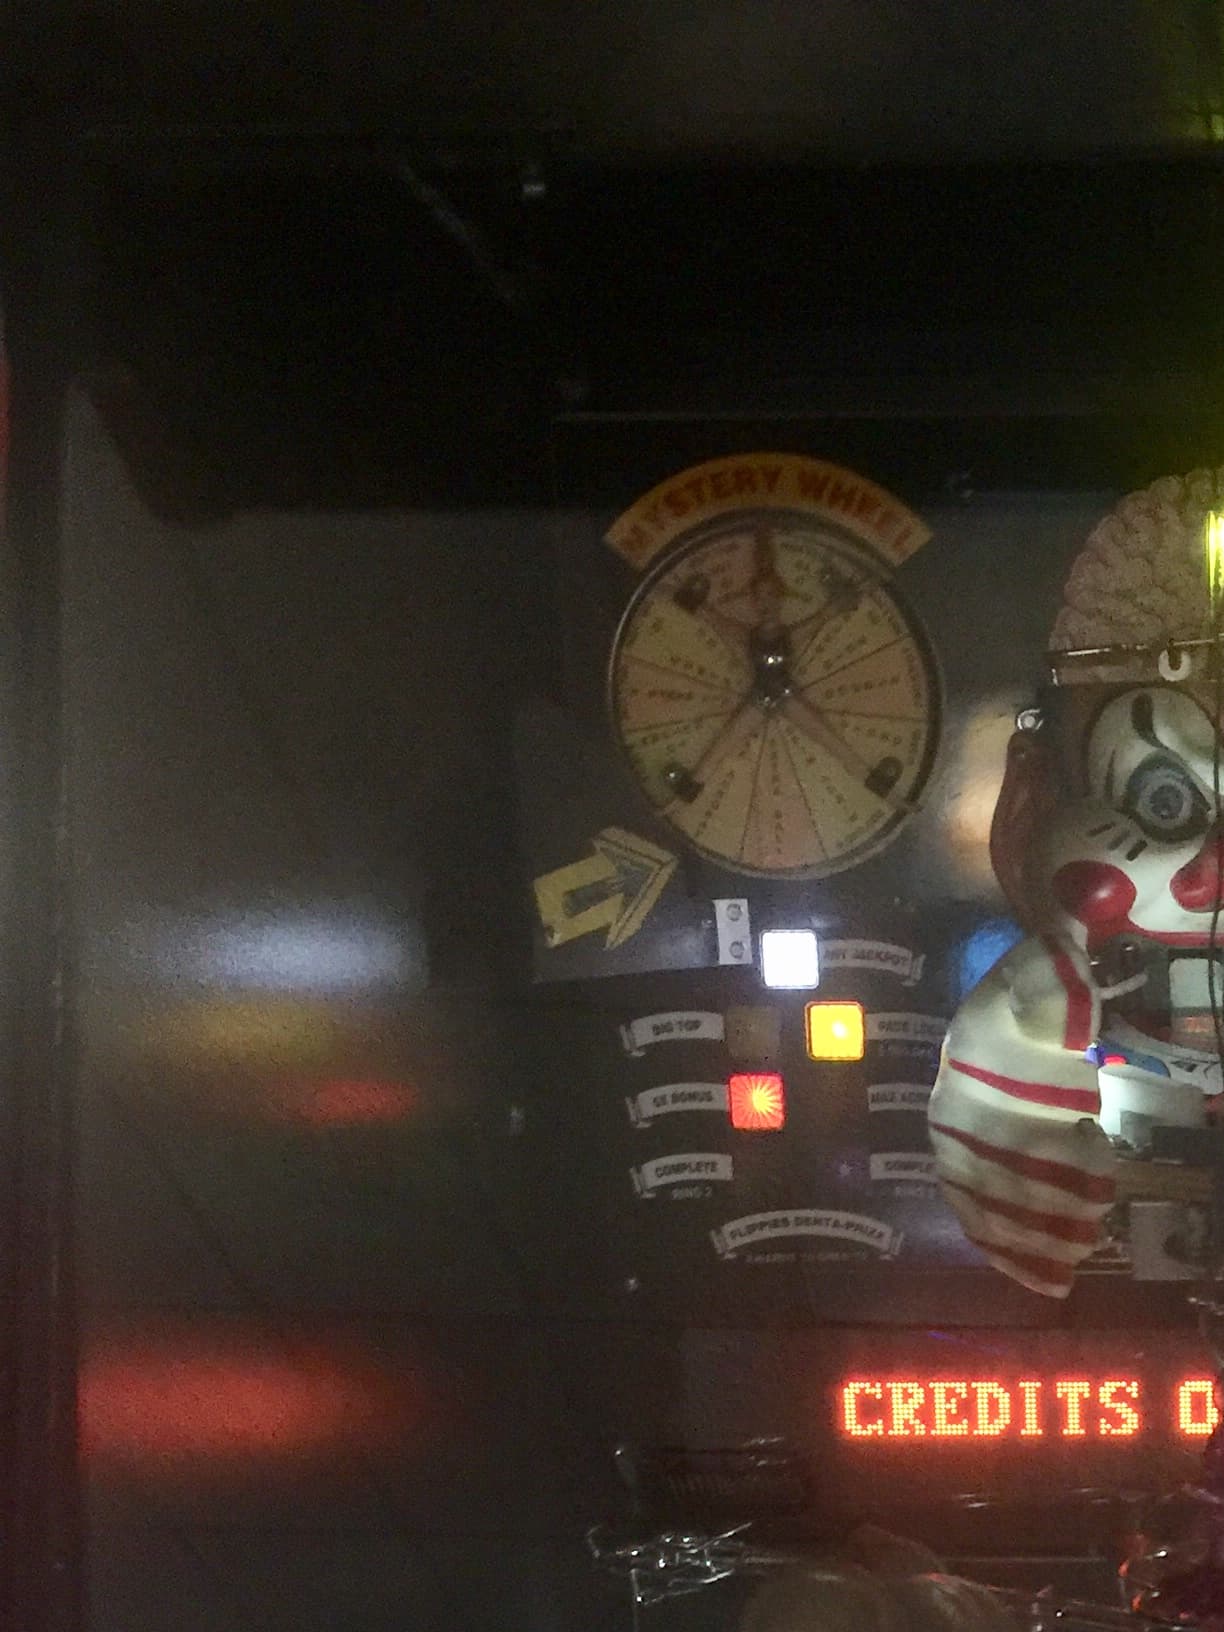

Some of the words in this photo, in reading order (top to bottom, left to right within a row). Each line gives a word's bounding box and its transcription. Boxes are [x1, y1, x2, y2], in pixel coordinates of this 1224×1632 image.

[619, 466, 782, 560] MYSTERY
[796, 470, 913, 557] WHEEL
[655, 1161, 719, 1178] COMPLETE
[842, 1380, 1140, 1436] CREDITS
